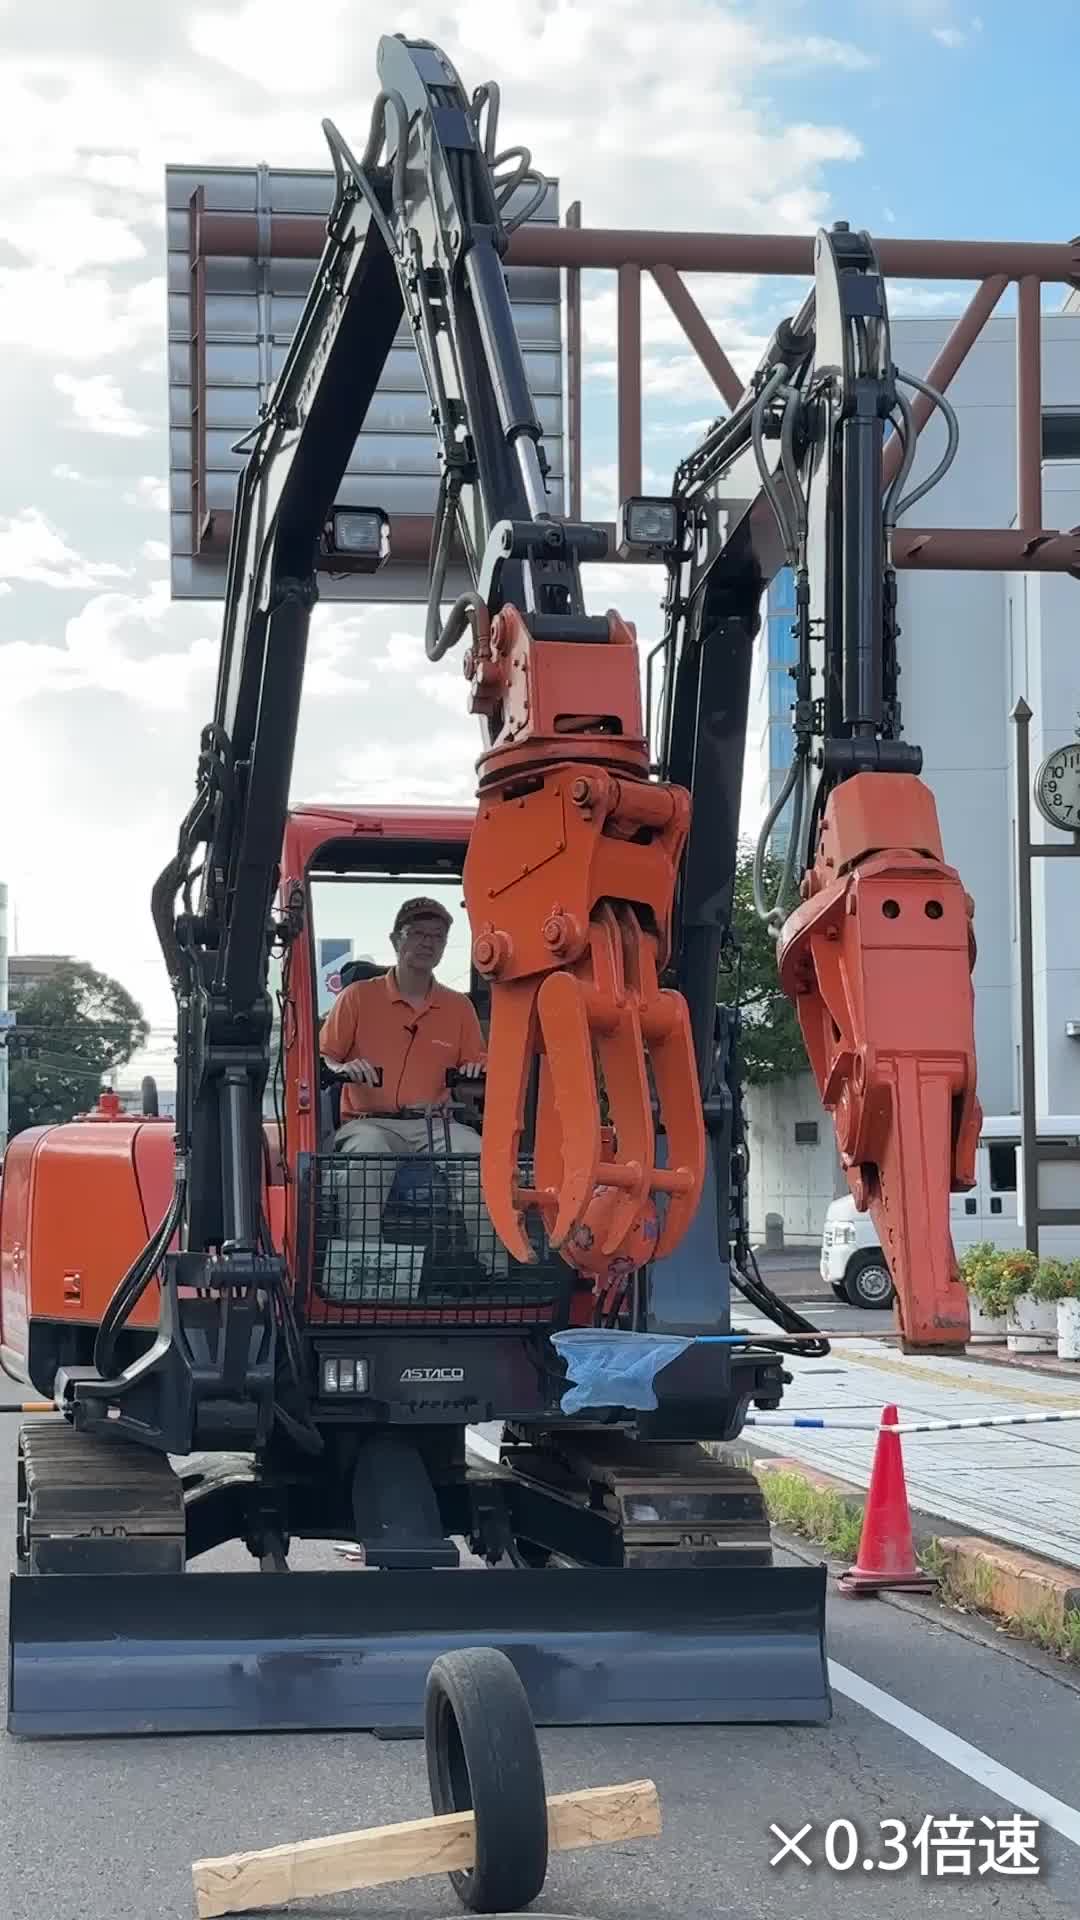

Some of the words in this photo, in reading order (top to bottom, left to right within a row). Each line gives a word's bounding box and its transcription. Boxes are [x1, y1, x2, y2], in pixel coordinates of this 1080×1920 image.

[1062, 752, 1074, 768] 11
[1048, 766, 1065, 779] 10
[1047, 780, 1057, 793] 9
[1053, 793, 1063, 806] 8
[1064, 805, 1074, 817] 7
[400, 1368, 464, 1380] ASTACO
